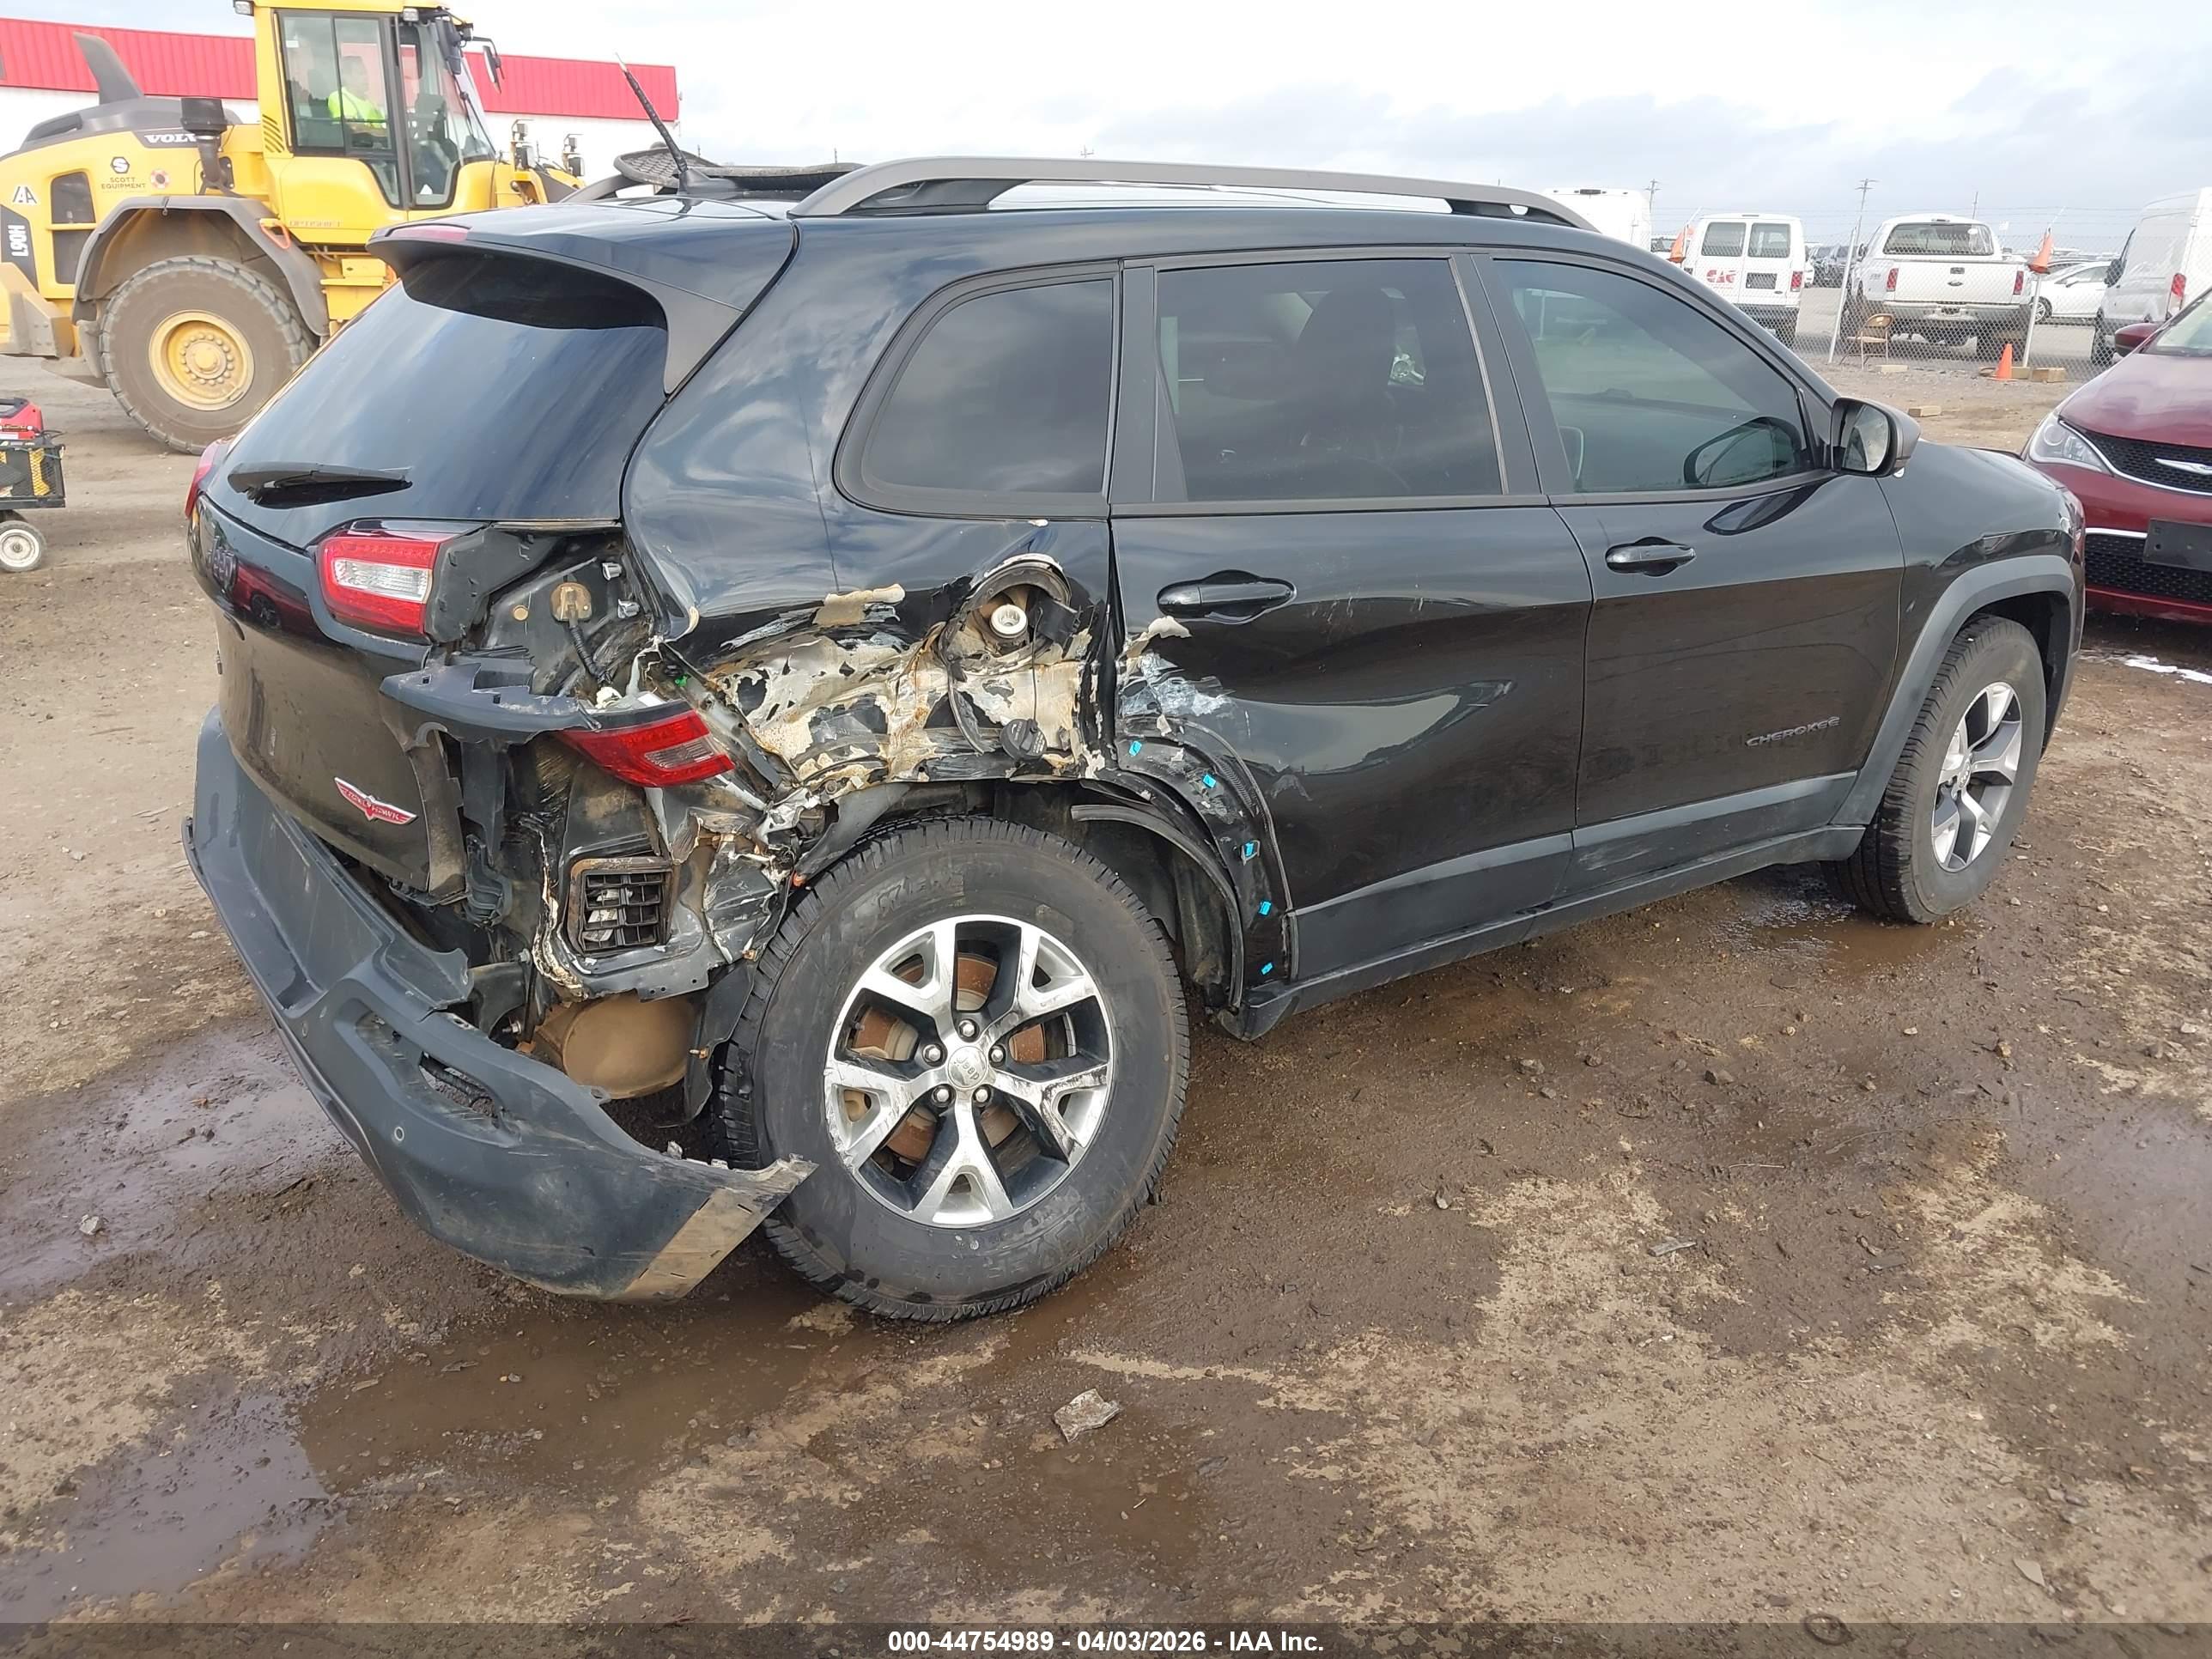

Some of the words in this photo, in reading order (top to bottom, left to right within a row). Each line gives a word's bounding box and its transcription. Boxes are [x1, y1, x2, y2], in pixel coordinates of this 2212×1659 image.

[144, 133, 198, 143] VOLV
[8, 224, 28, 257] L90H
[1746, 716, 1840, 746] CHEROKEE
